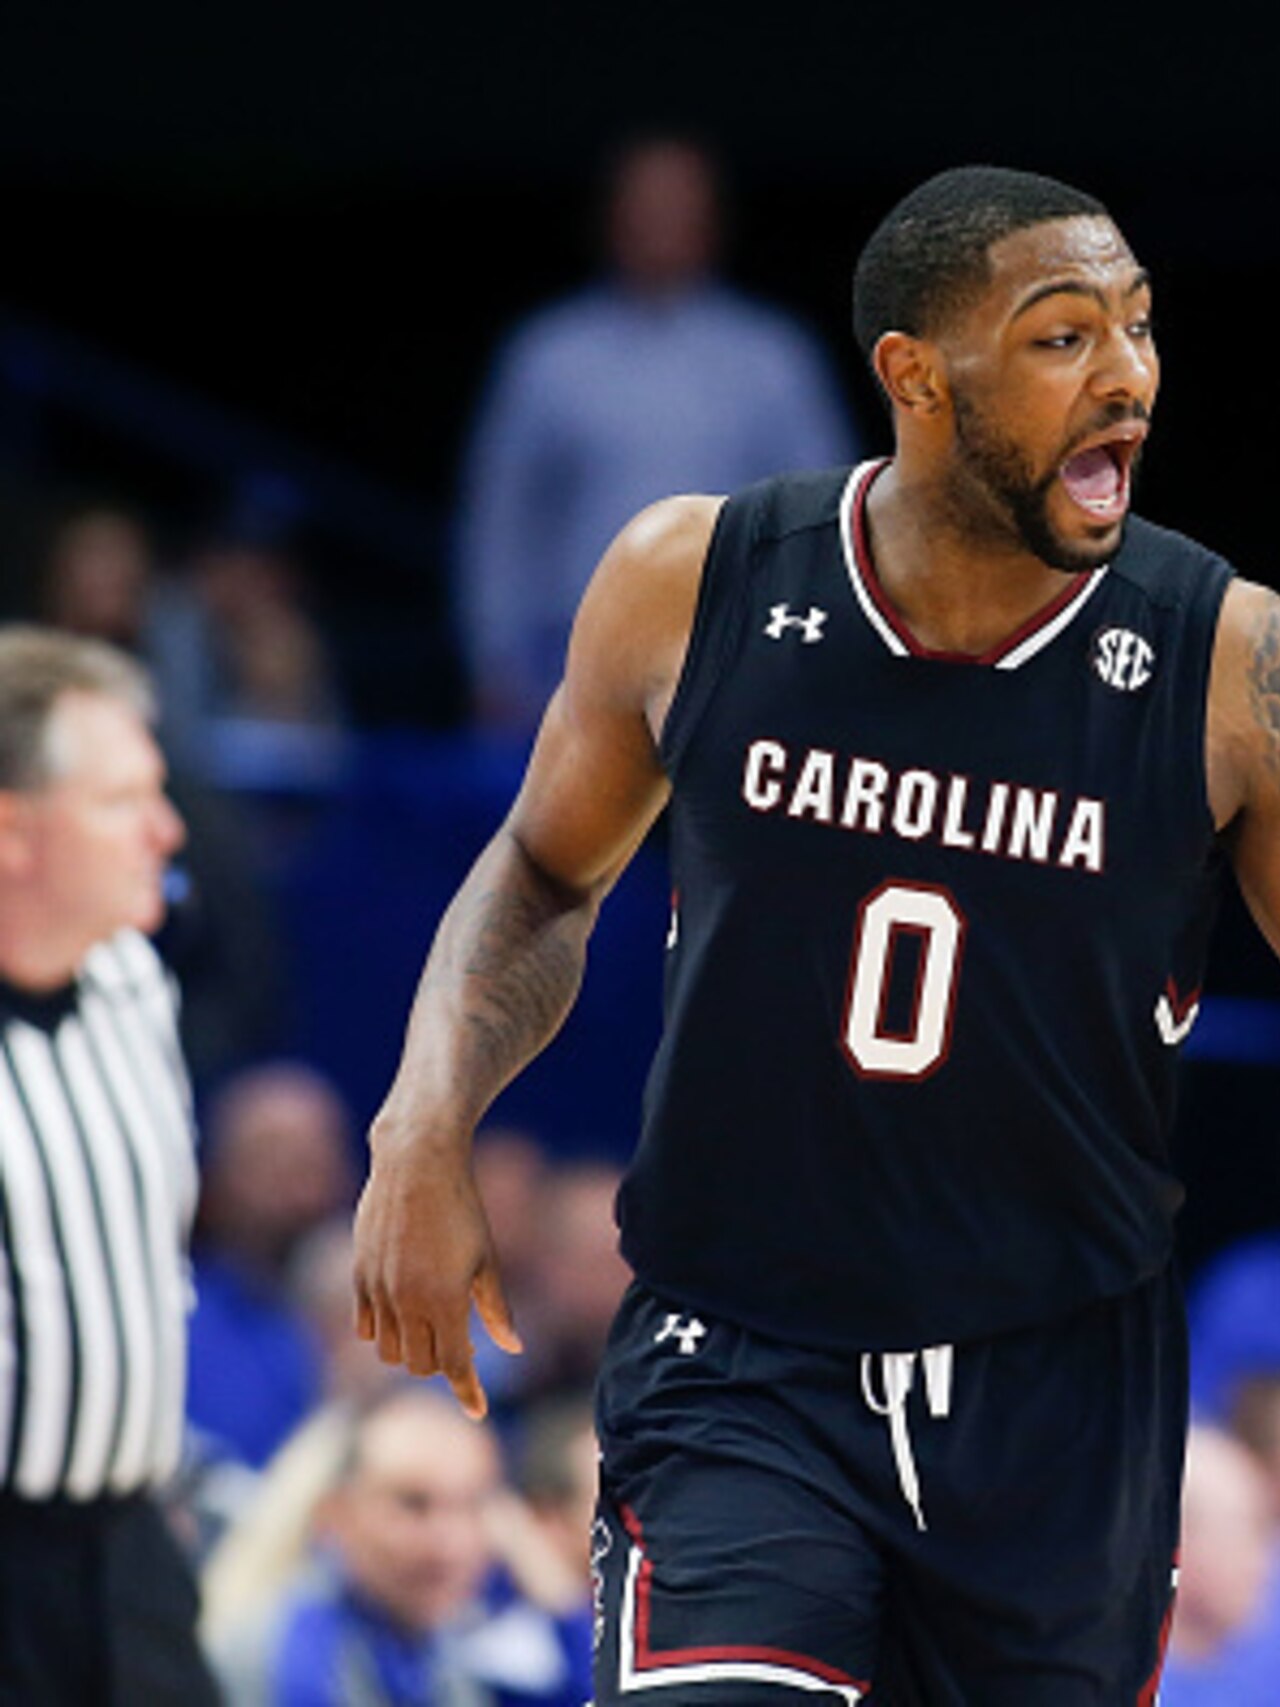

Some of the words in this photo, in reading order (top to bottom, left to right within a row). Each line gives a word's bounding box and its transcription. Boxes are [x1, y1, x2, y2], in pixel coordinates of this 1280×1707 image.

[1095, 628, 1155, 691] SEC
[742, 738, 1105, 874] CAROLINA
[841, 877, 967, 1083] 0
